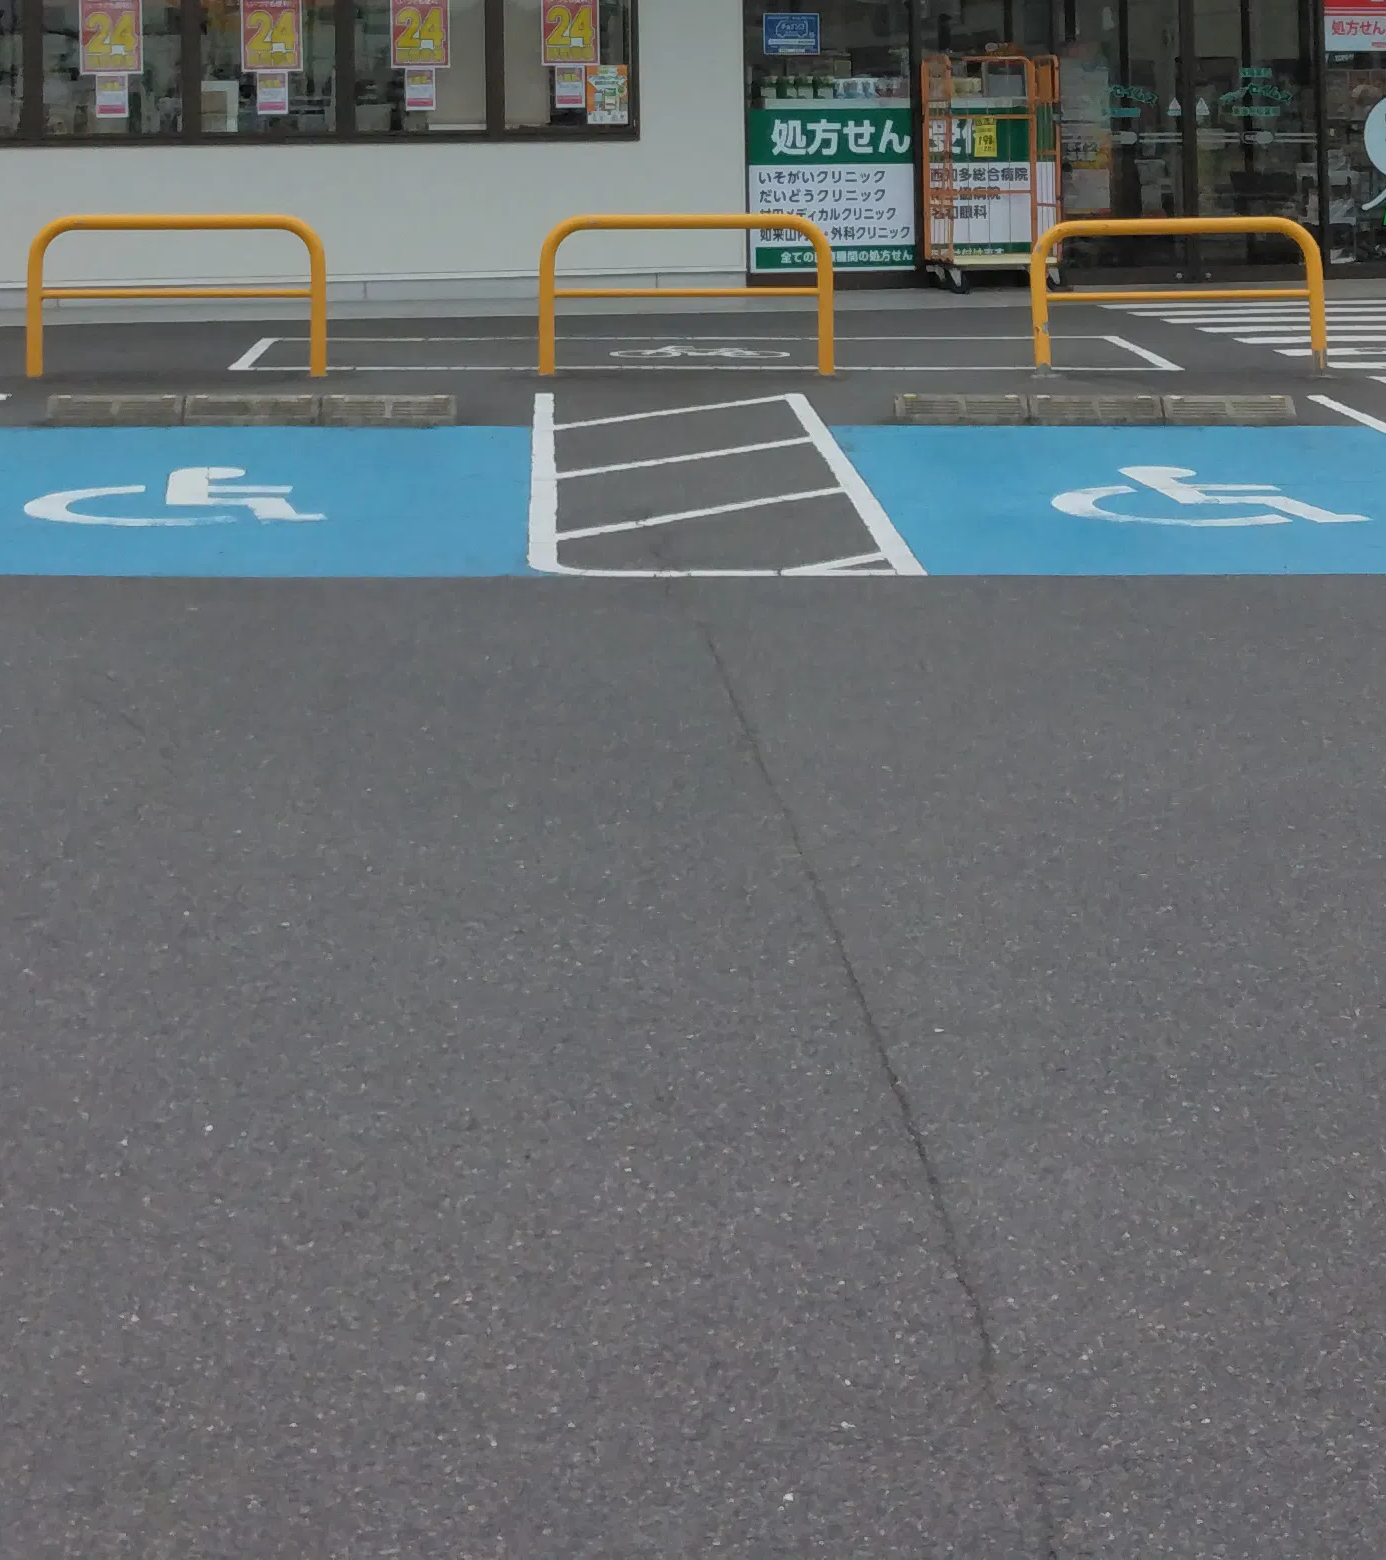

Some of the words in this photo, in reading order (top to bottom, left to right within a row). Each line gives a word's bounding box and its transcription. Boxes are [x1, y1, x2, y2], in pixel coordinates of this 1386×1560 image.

[85, 11, 137, 54] 24
[247, 10, 298, 51] 24
[396, 8, 445, 48] 24
[547, 6, 595, 46] 24
[758, 170, 885, 184] いそがいクリニック
[759, 189, 886, 204] だいどうクリニック
